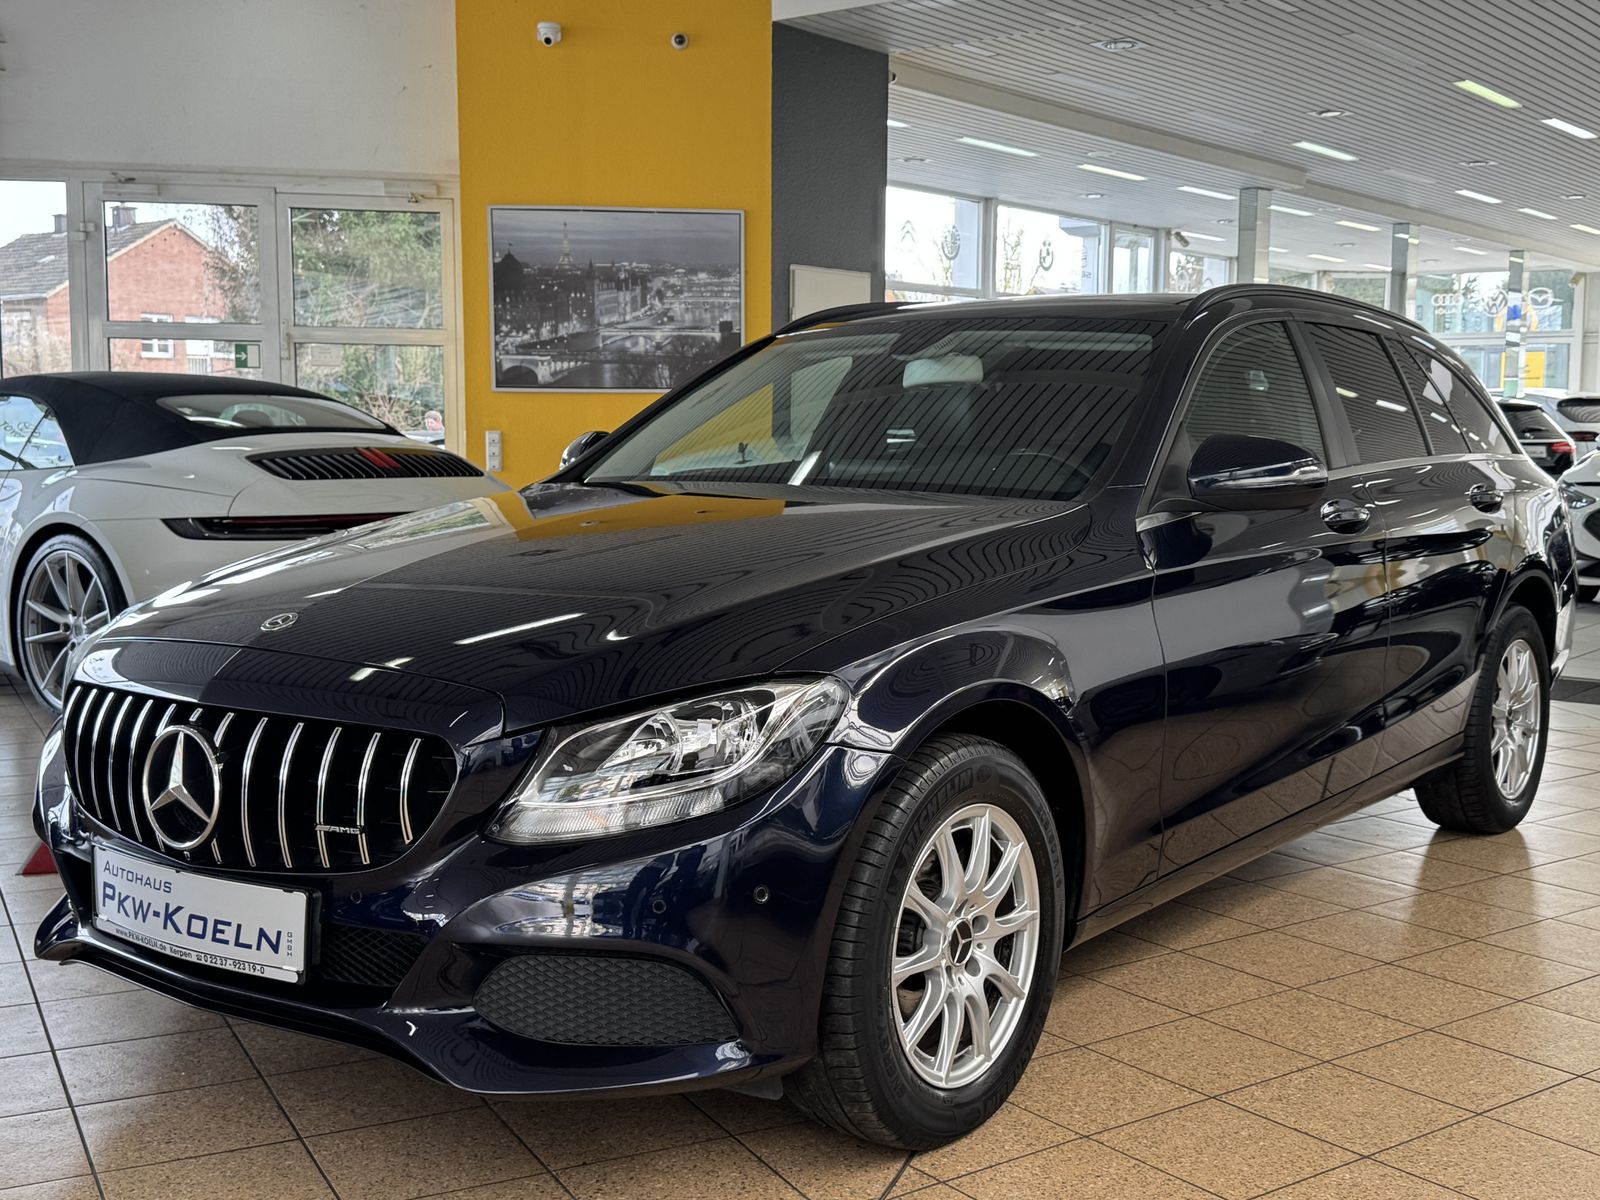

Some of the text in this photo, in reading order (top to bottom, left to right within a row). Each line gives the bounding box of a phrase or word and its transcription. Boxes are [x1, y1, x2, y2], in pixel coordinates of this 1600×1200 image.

[903, 768, 972, 858] MICHELIN
[329, 826, 360, 834] AMG
[104, 861, 172, 893] AUTOHAUS
[103, 881, 282, 955] PKW-KOELN
[115, 928, 167, 952] www.PKW-KOELN.de
[169, 946, 192, 959] Kerpen
